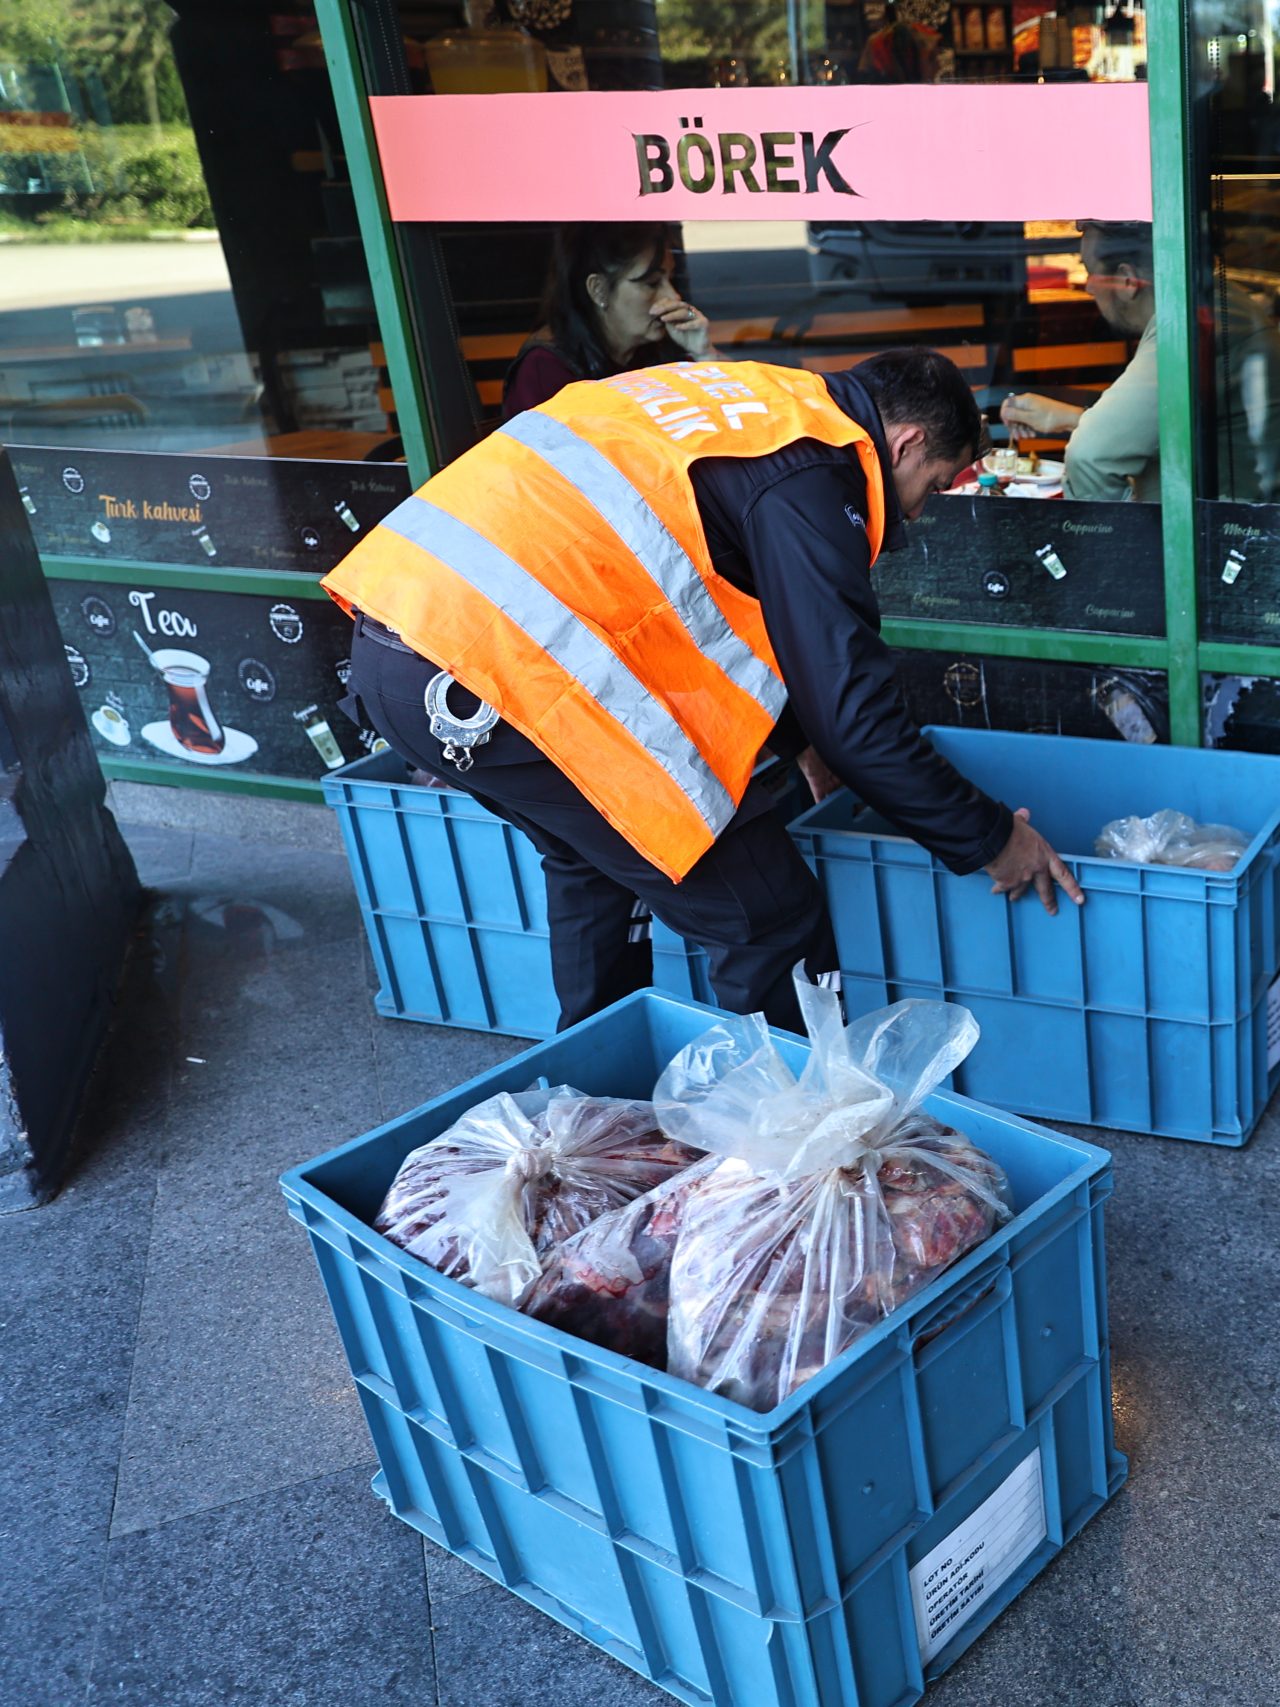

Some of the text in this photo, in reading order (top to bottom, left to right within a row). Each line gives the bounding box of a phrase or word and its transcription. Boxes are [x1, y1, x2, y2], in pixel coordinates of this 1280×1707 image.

[632, 116, 860, 198] BÖREK
[143, 500, 203, 523] kahvesi
[1223, 522, 1261, 537] Mocha
[128, 590, 198, 638] Tea
[923, 1558, 953, 1588] LOT NO
[926, 1577, 949, 1600] ÜRÜN
